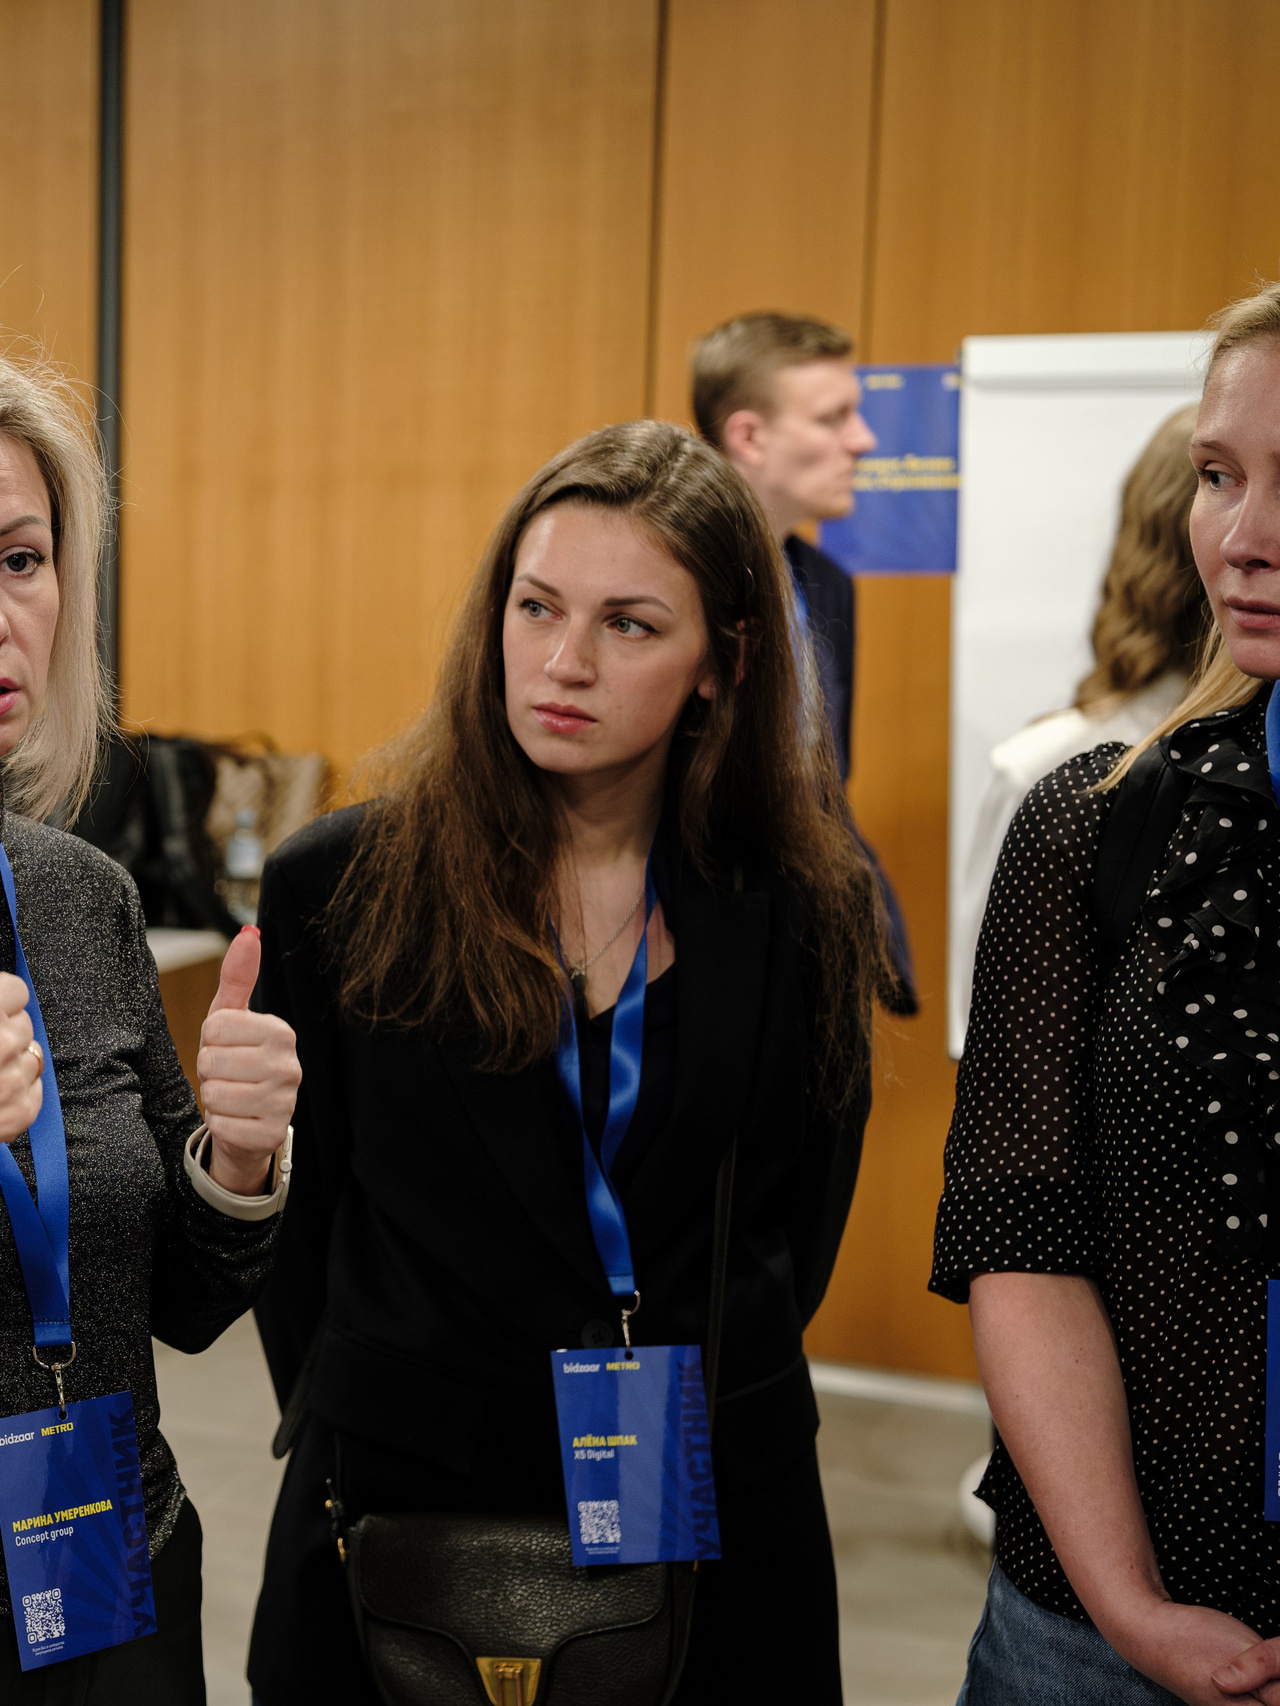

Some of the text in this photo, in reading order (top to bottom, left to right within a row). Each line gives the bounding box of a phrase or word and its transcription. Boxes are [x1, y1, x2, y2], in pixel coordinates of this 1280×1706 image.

[563, 1361, 640, 1373] bidzaar METRO
[41, 1422, 74, 1436] METRO
[572, 1434, 607, 1447] АЛЁНА
[586, 1448, 615, 1461] Digital
[12, 1499, 113, 1533] МАРИНА УМЕРЕНКОВА
[109, 1412, 157, 1637] УЧАСТНИК
[15, 1526, 74, 1547] Concept group
